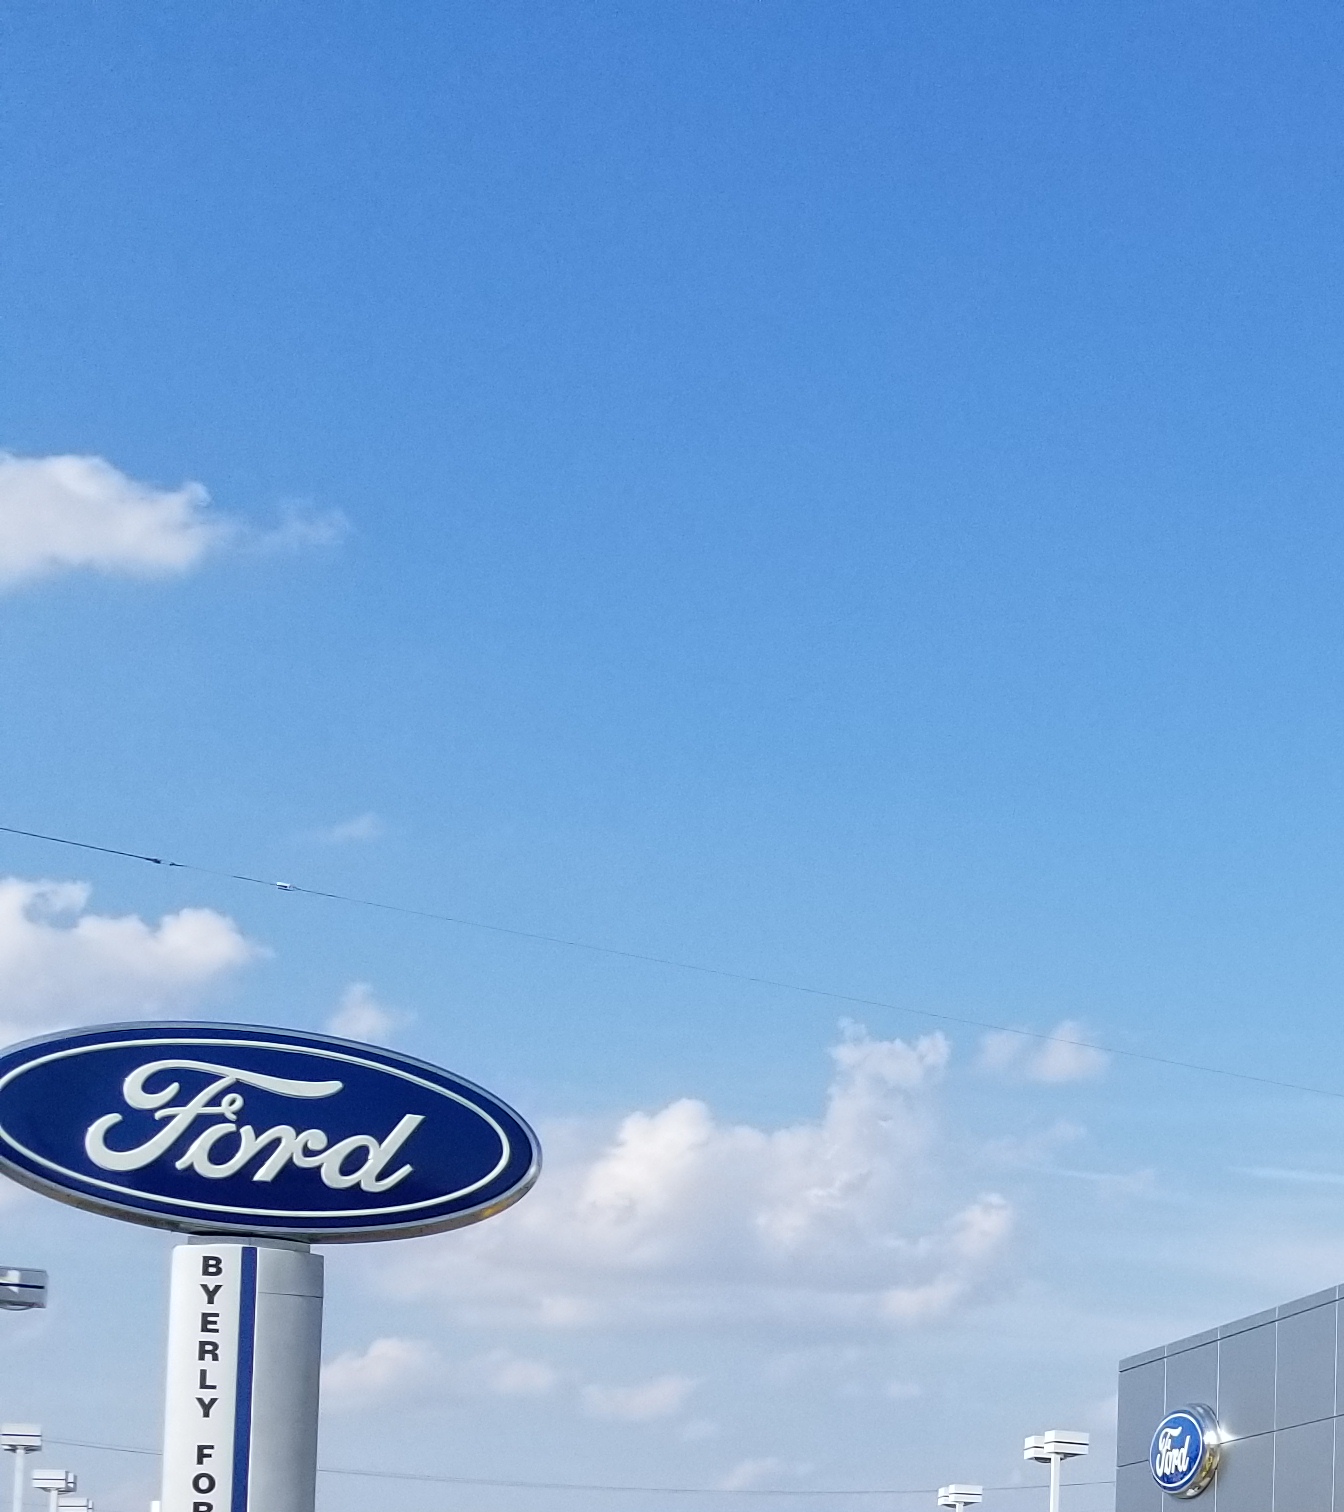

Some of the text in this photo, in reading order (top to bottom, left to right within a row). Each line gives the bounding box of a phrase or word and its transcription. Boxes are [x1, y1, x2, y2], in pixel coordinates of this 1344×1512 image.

[85, 1058, 427, 1194] Ford
[194, 1255, 224, 1419] BYERLY
[1155, 1425, 1192, 1478] Ford
